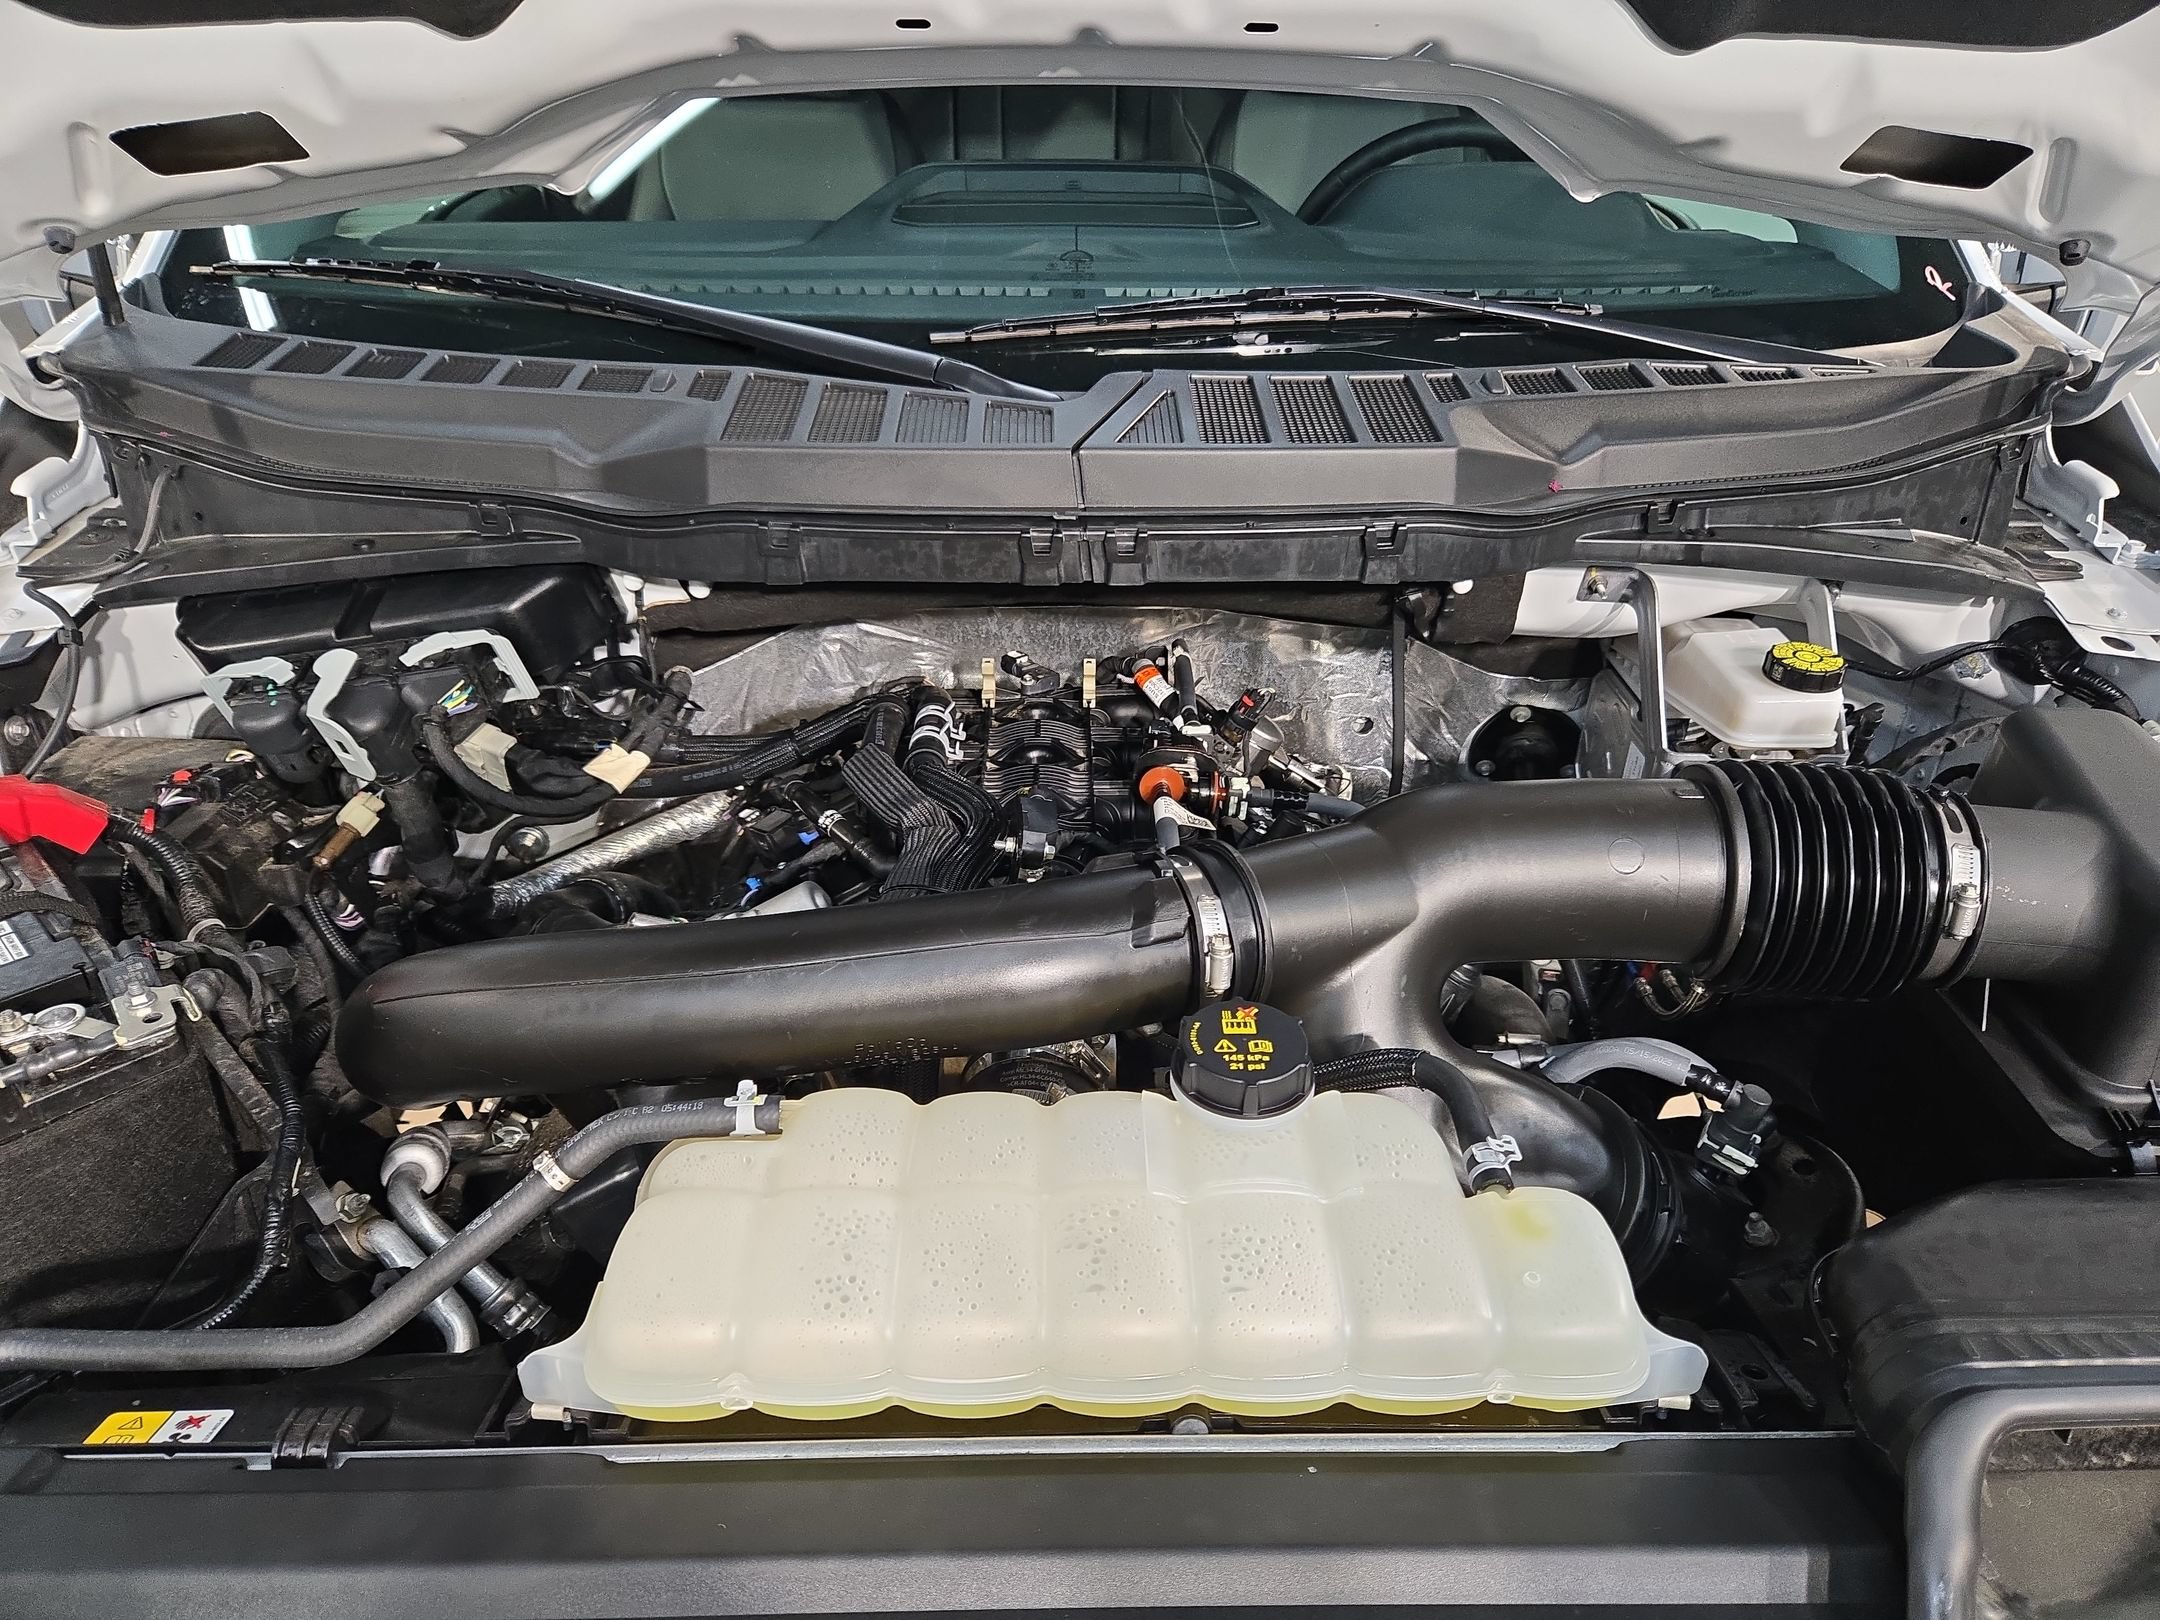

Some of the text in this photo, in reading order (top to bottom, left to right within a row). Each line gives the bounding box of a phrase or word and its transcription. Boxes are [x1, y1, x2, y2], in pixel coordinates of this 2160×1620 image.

[1222, 1054, 1270, 1062] 145 kPa
[1229, 1062, 1266, 1071] 21 psi
